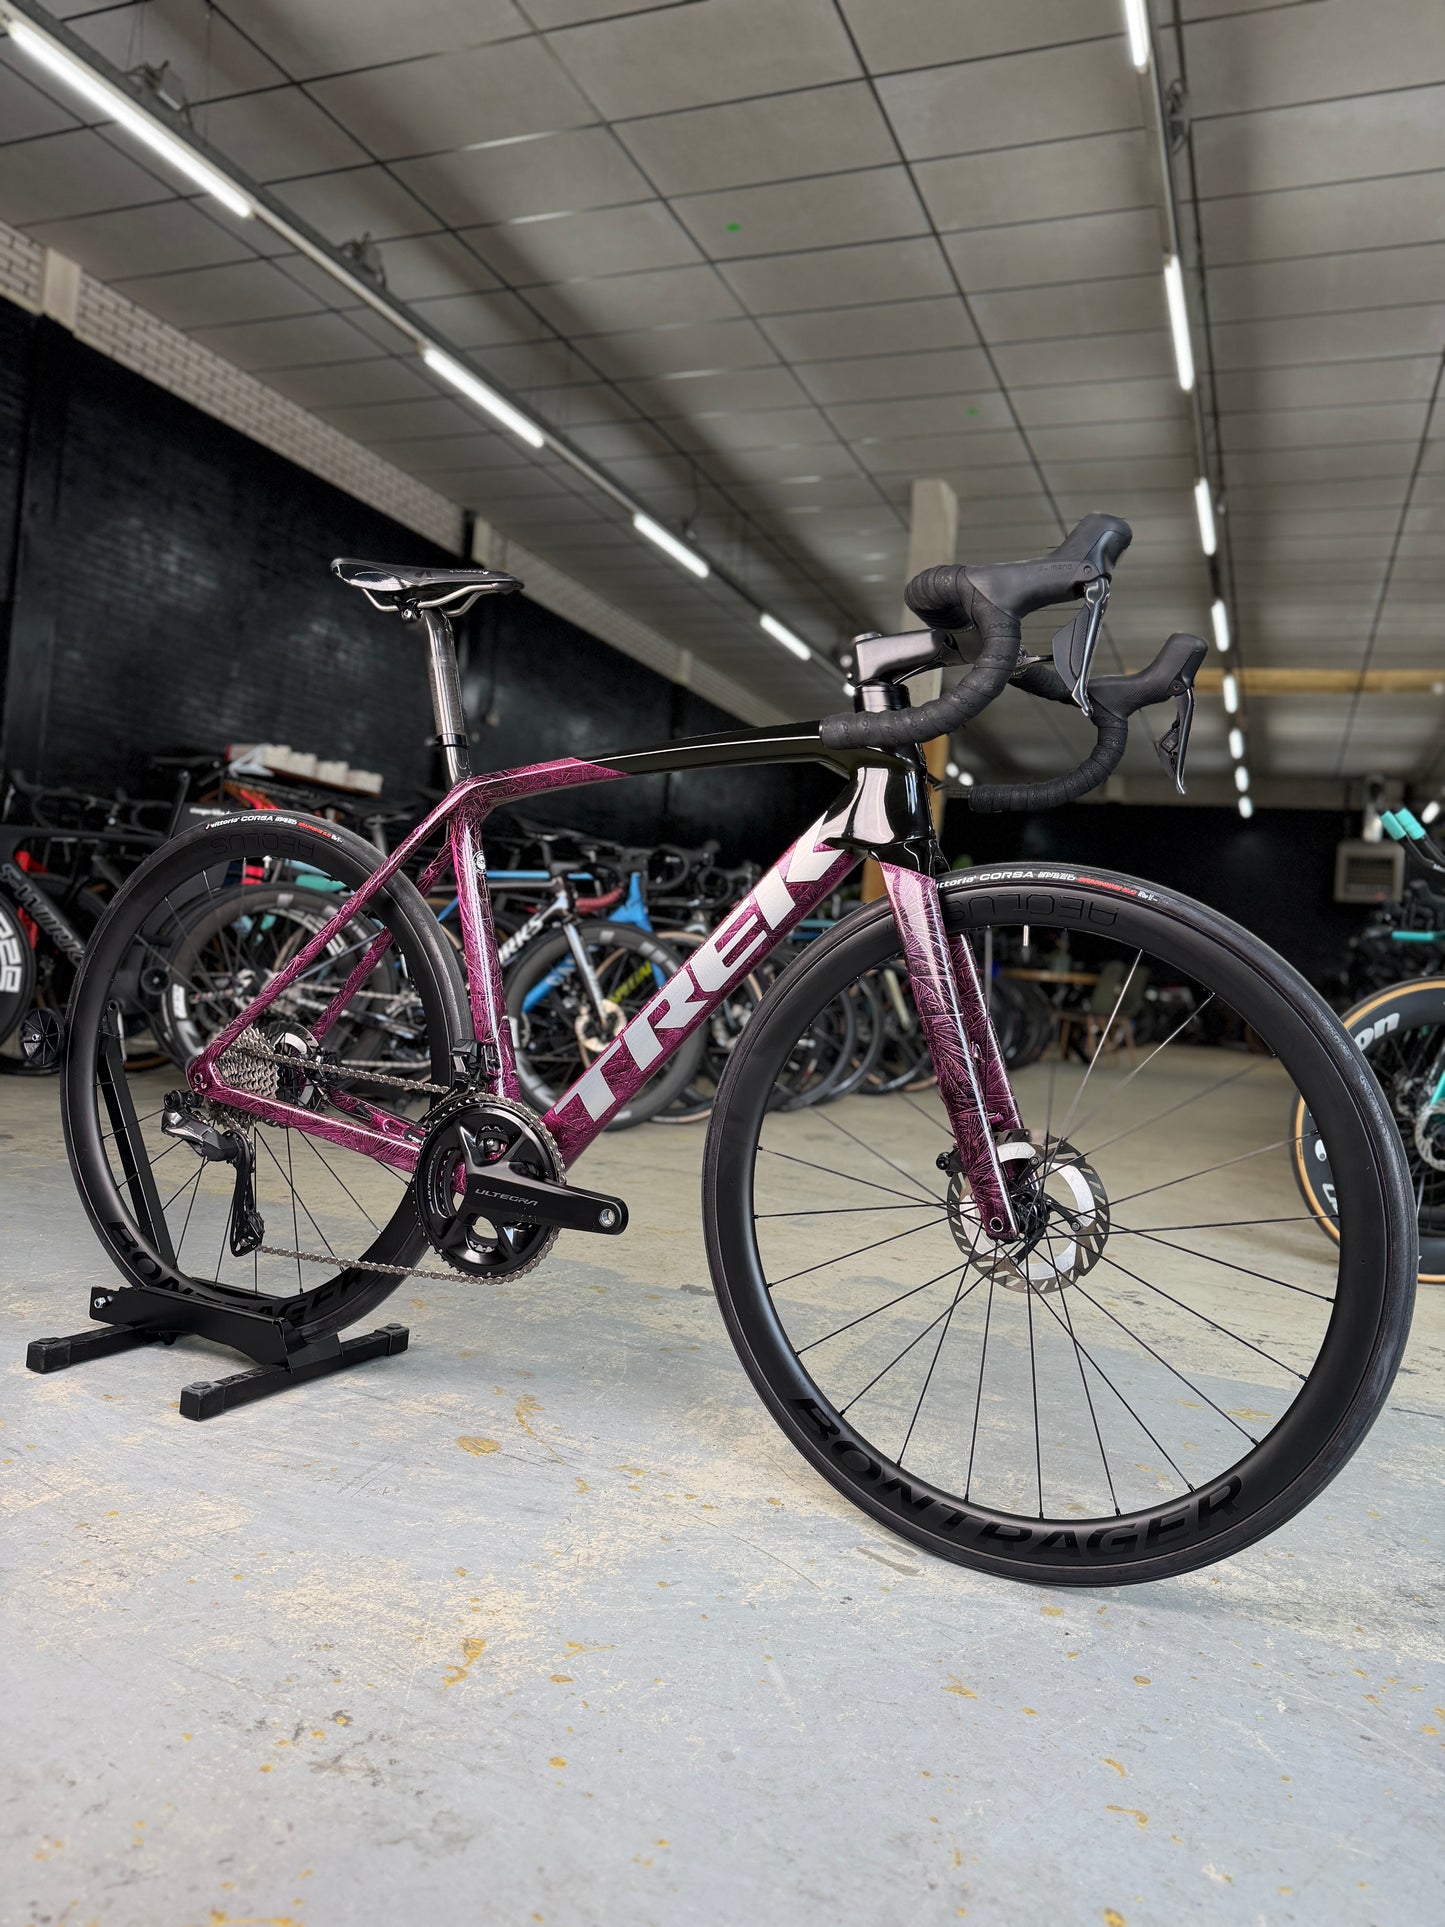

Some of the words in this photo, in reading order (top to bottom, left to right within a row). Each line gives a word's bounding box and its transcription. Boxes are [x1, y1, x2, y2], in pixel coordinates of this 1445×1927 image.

[979, 871, 1034, 880] CORSA
[555, 811, 844, 1121] TREK
[475, 1188, 539, 1207] ULTEGRA
[800, 1400, 1243, 1558] BONTRAGER
